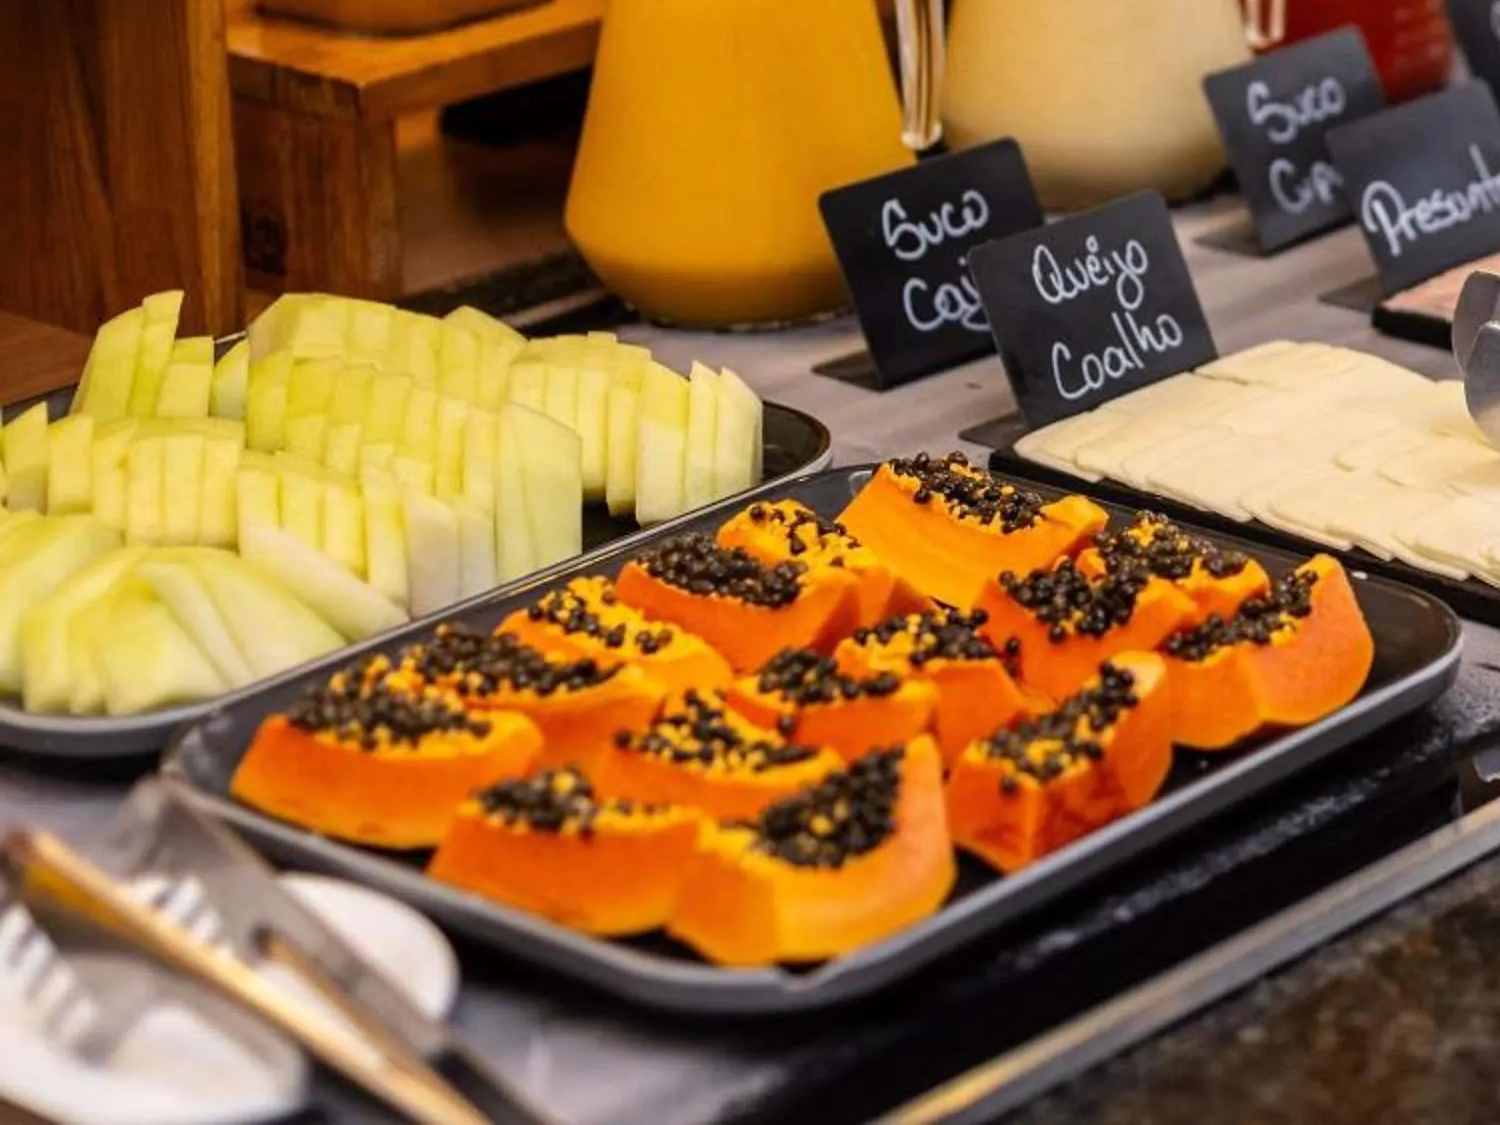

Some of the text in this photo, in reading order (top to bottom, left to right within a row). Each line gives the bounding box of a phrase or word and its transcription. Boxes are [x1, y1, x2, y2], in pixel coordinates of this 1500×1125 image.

[1246, 76, 1346, 144] Suco
[882, 189, 990, 261] Suco
[1031, 235, 1150, 310] Queijo
[1051, 311, 1183, 402] Coalho
